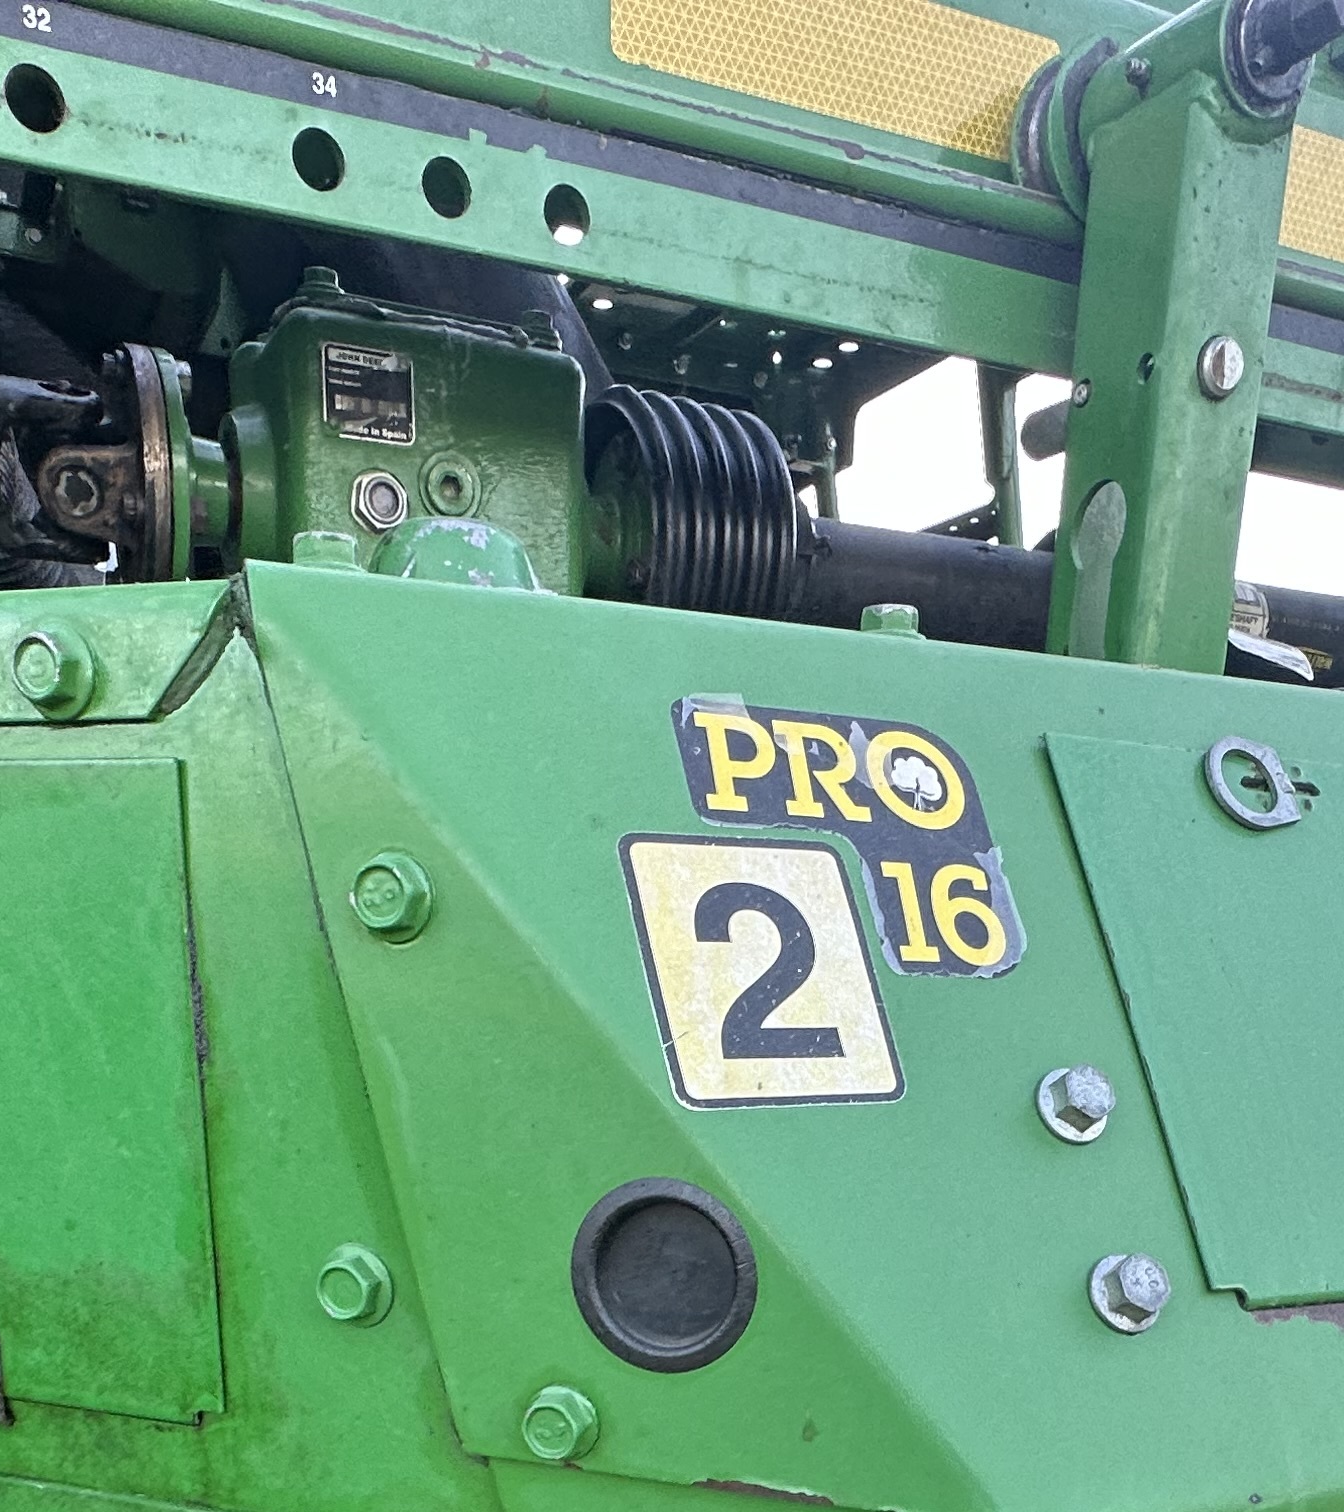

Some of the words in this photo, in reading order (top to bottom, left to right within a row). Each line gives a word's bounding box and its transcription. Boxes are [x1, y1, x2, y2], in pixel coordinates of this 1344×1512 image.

[22, 4, 52, 32] 32
[312, 72, 337, 98] 34
[693, 711, 966, 831] PRO
[880, 860, 1007, 968] 16
[693, 881, 847, 1060] 2
